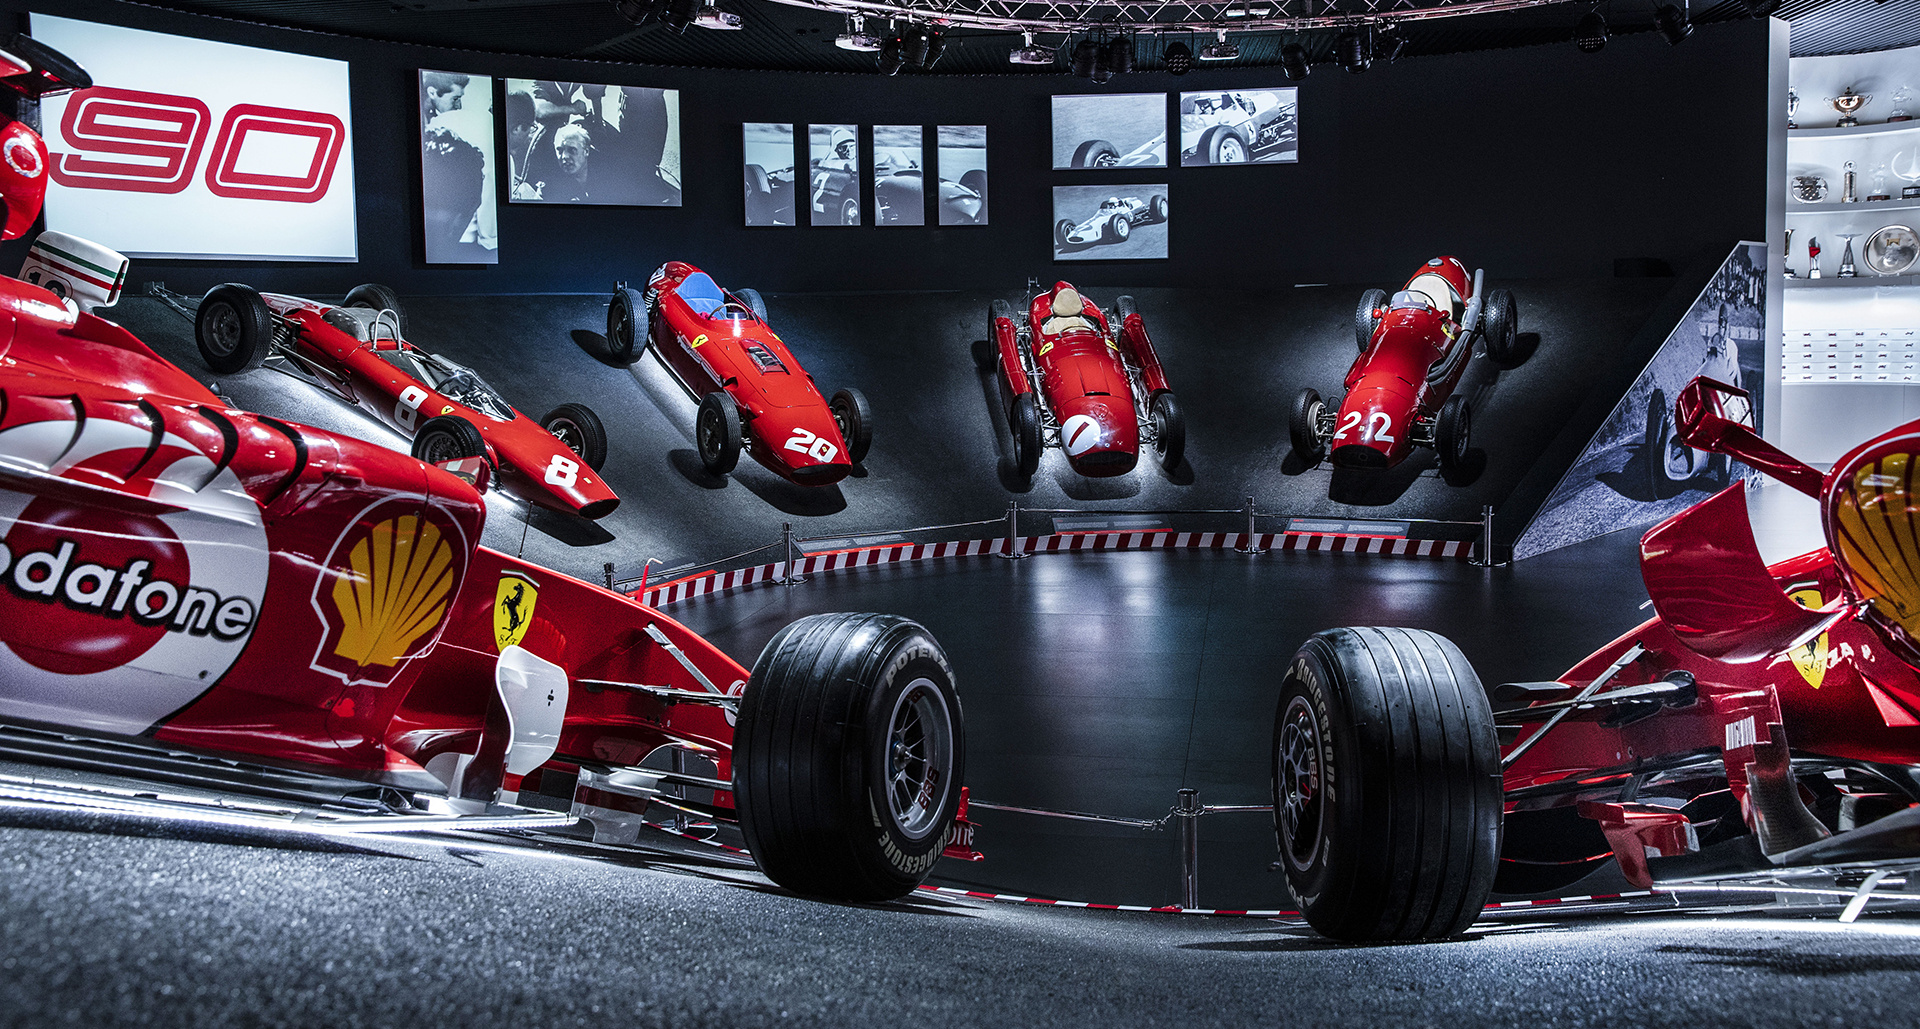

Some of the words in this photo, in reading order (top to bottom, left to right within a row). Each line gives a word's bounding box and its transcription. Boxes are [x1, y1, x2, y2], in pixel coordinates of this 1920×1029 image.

[49, 85, 345, 203] 90
[394, 385, 429, 431] 8
[1333, 410, 1395, 443] 22
[783, 427, 839, 463] 20
[544, 454, 580, 489] 8
[0, 541, 253, 637] dafone
[1296, 658, 1336, 803] BRIDGESTONE
[918, 766, 940, 811] BBS
[1307, 747, 1319, 790] BBS
